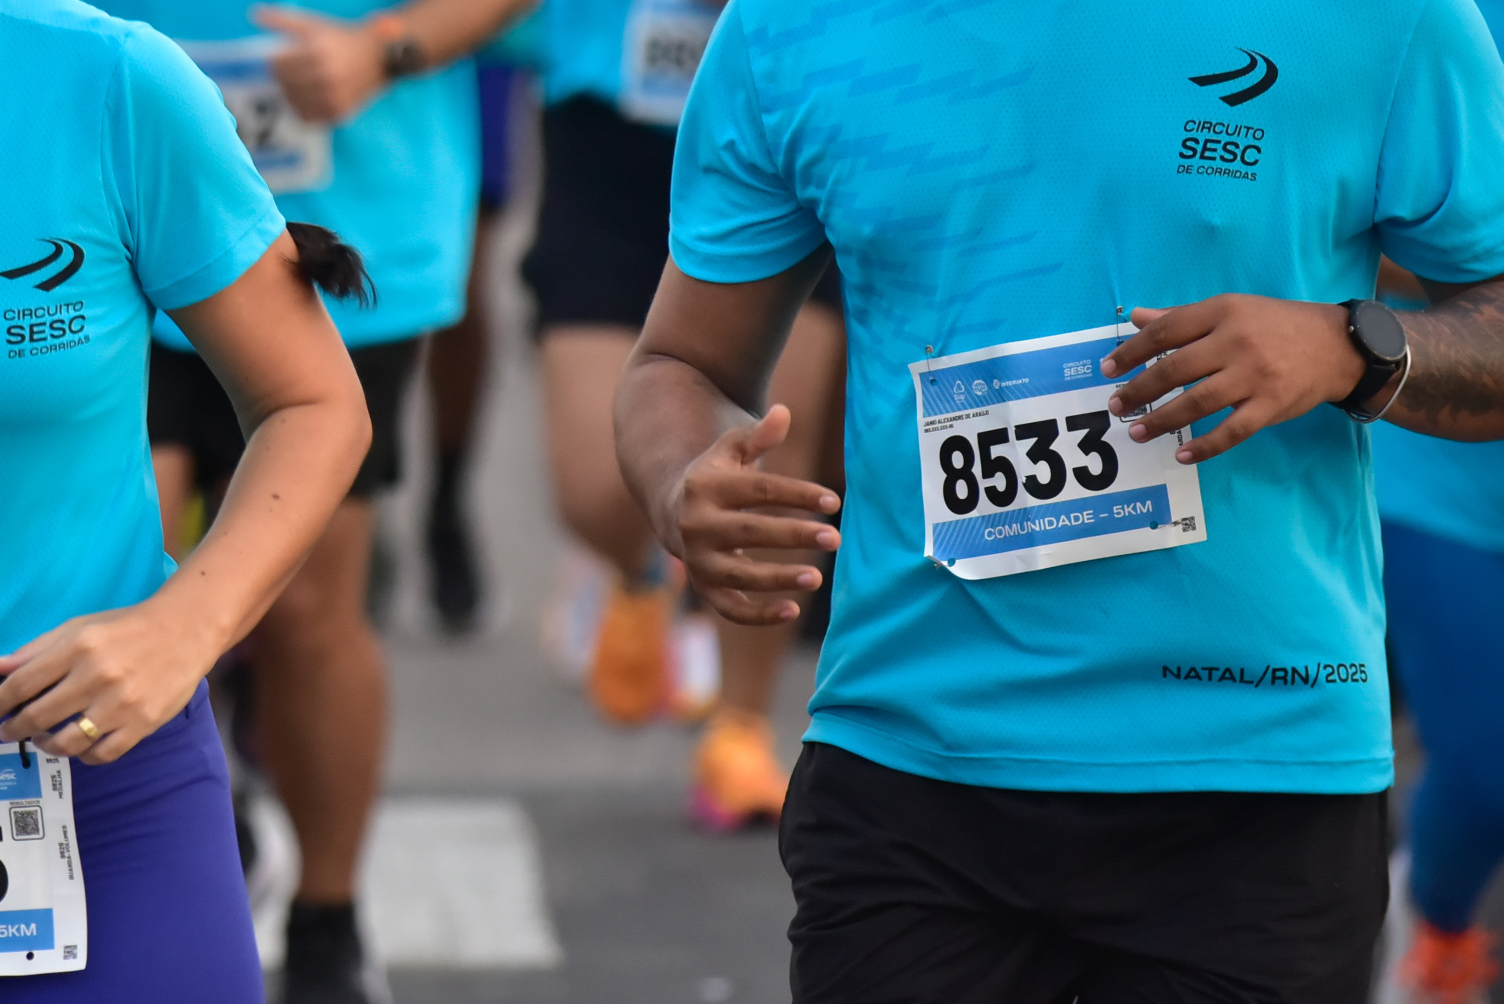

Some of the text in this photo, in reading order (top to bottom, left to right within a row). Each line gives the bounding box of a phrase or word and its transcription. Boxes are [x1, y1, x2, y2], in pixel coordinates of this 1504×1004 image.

[1183, 119, 1265, 141] CIRCUITO
[1178, 136, 1262, 167] SESC
[1176, 164, 1258, 182] DE CORRIDAS
[3, 300, 84, 321] CIRCUITO
[5, 314, 86, 345] SESC
[8, 334, 91, 359] DE CORRIDAS
[1063, 365, 1093, 377] SESC
[937, 414, 965, 424] ALEXANDRE
[939, 409, 1119, 515] 8533
[984, 509, 1095, 541] COMUNIDADE
[1112, 499, 1153, 519] 5KM
[1161, 661, 1368, 688] NATAL/RN/2025
